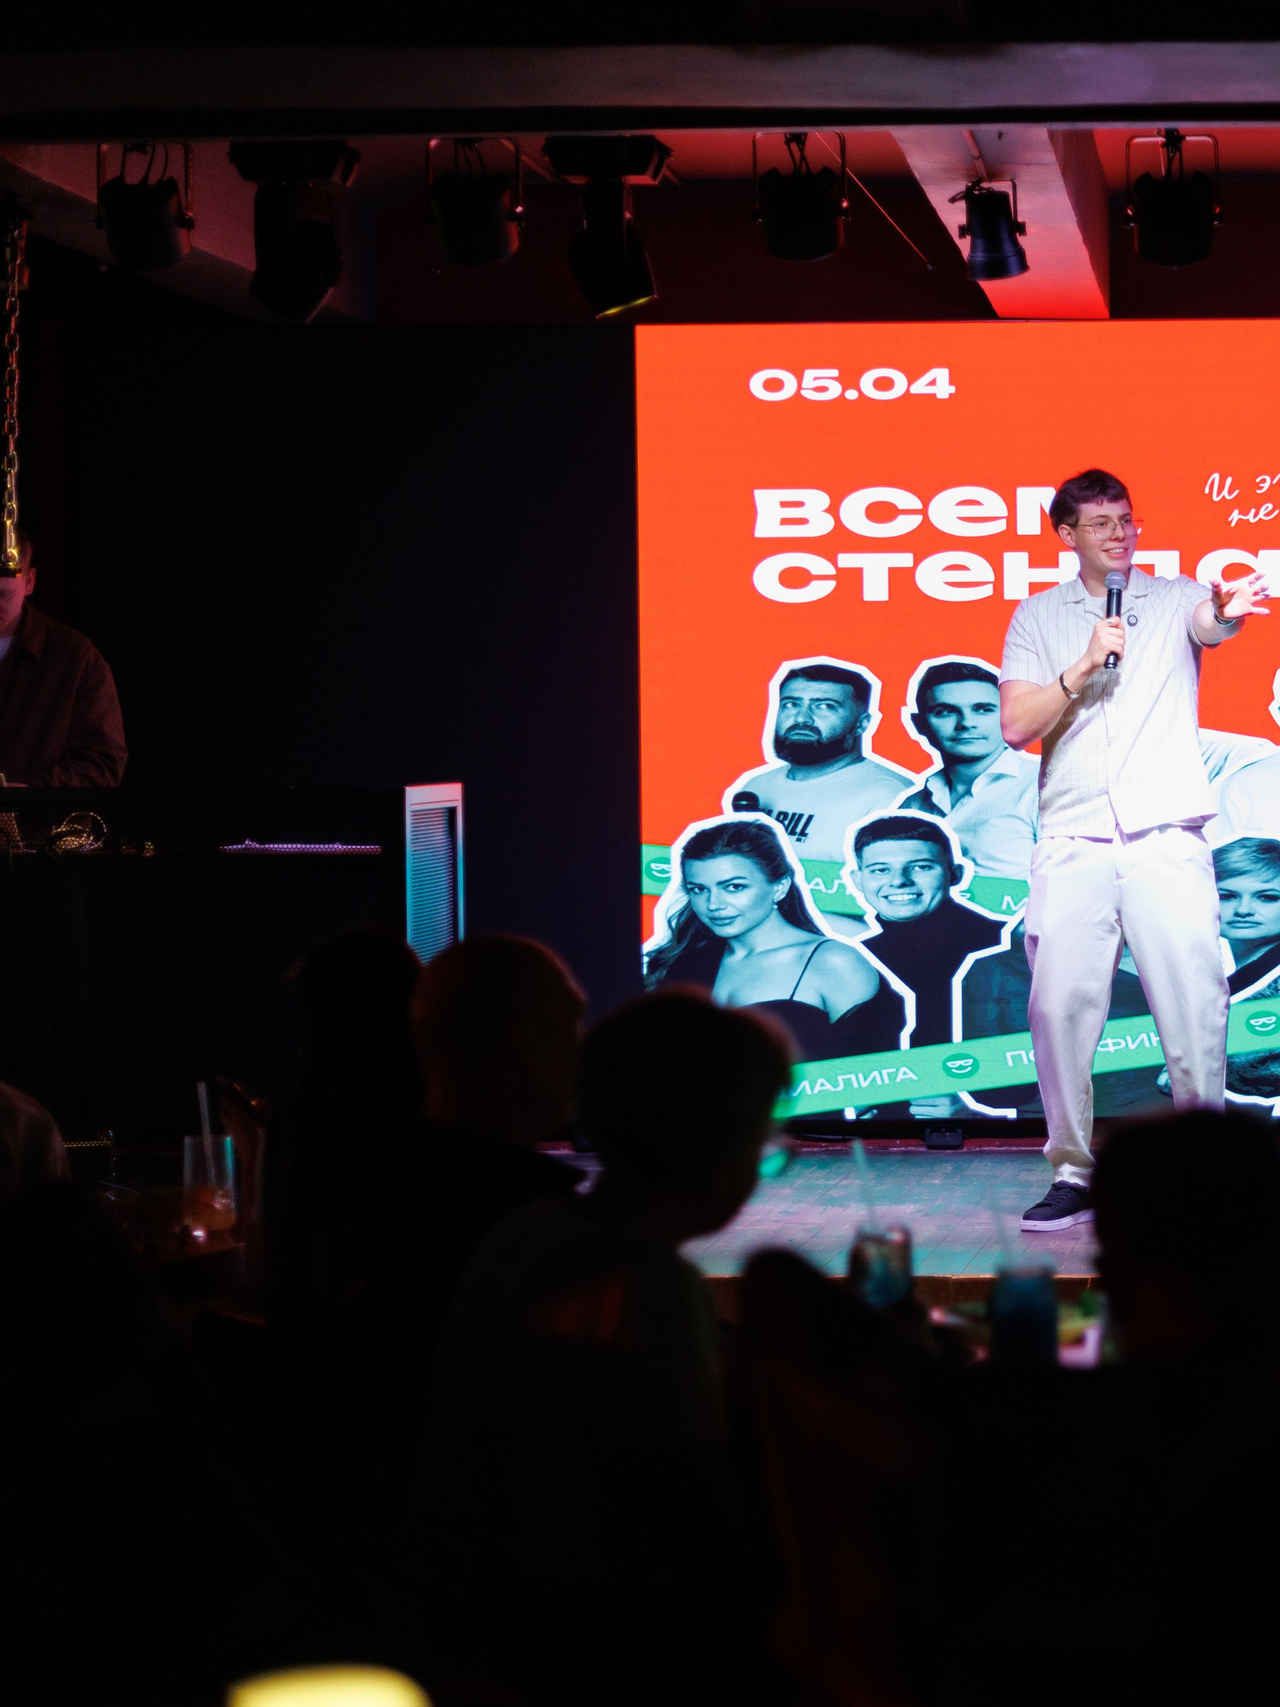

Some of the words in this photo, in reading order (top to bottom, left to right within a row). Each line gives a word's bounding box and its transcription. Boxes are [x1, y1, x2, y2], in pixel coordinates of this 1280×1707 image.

[749, 367, 956, 402] 05.04
[1204, 472, 1240, 502] И
[1227, 502, 1280, 528] не
